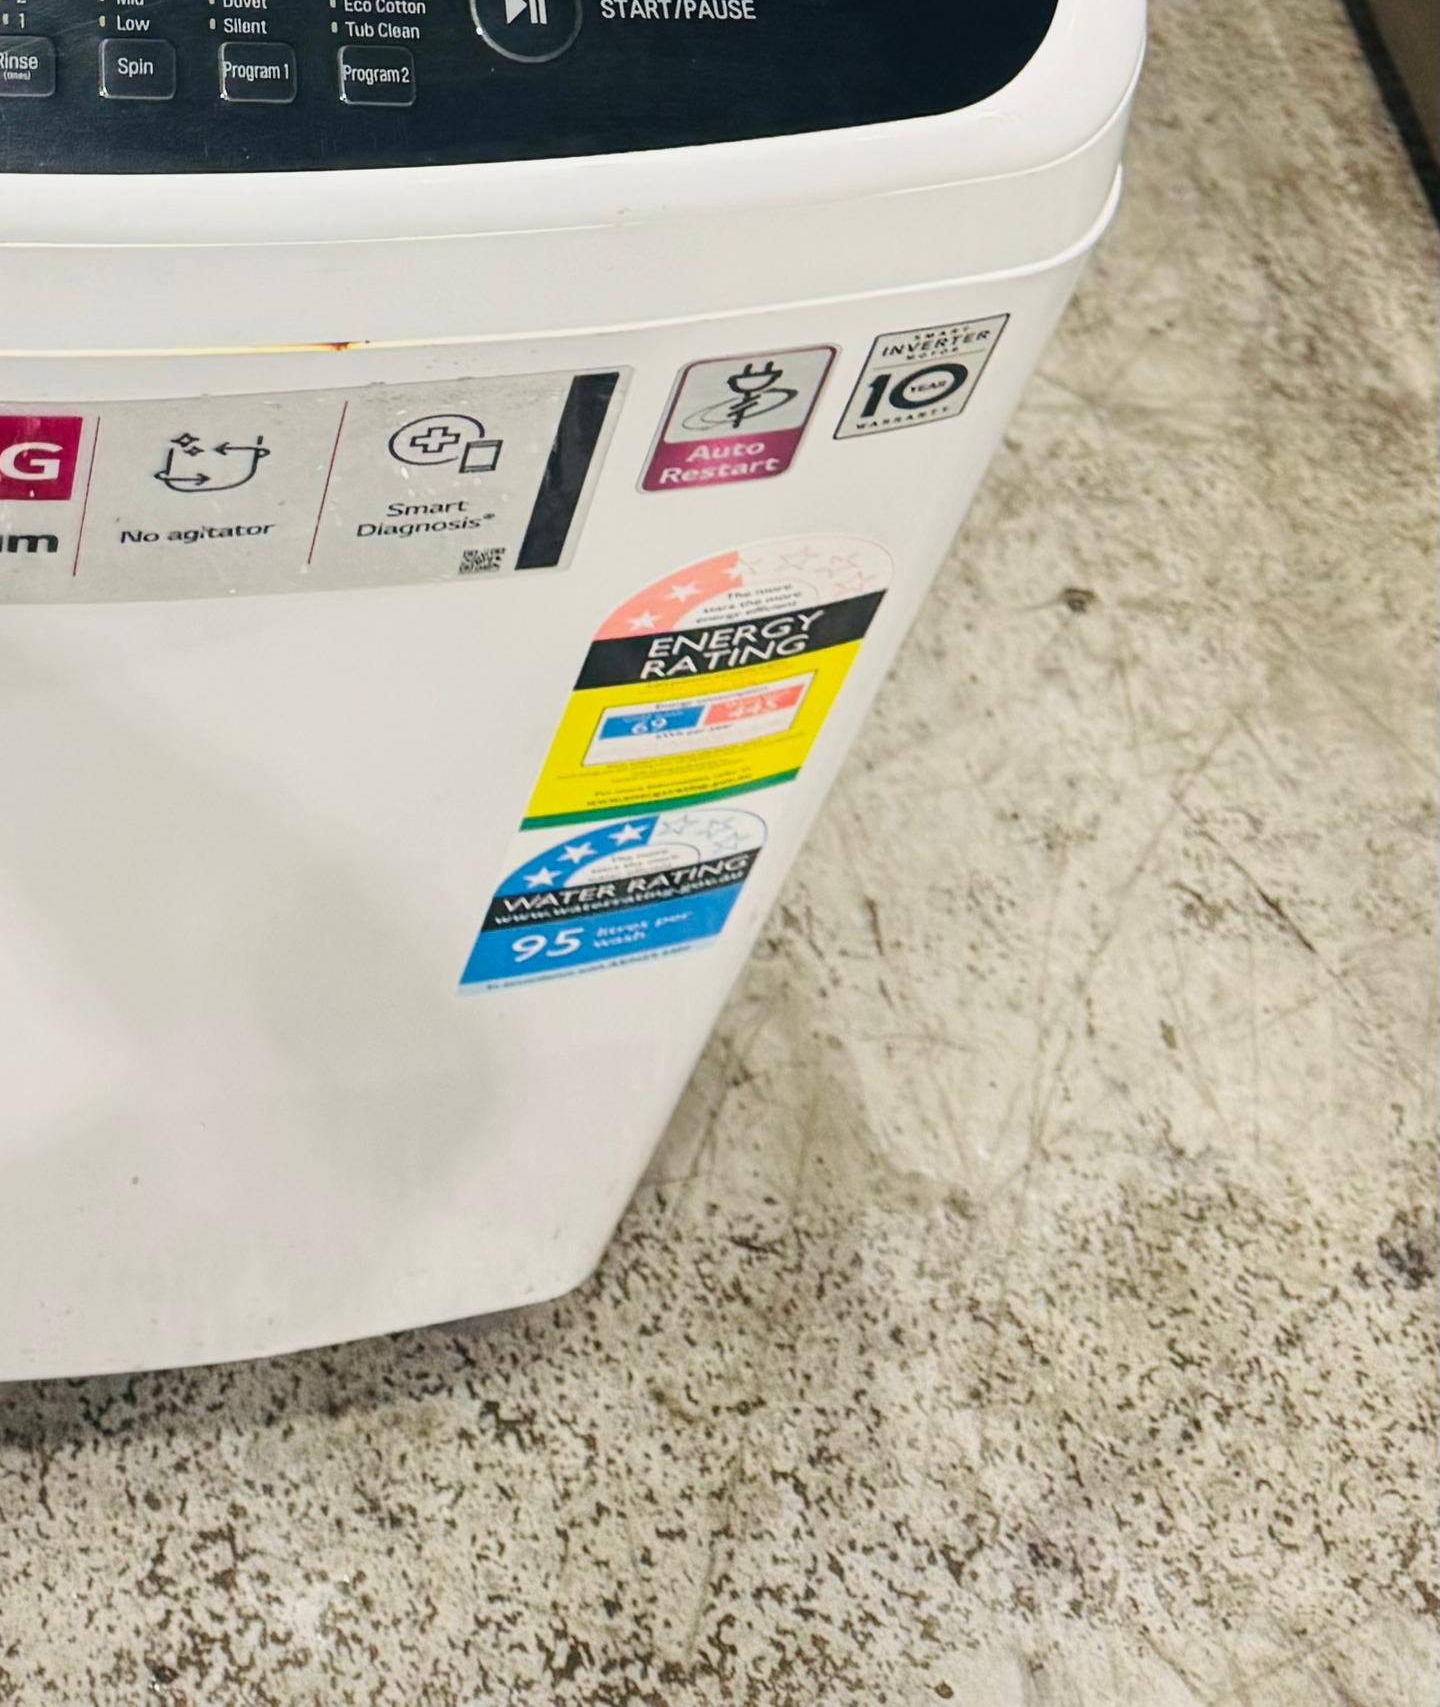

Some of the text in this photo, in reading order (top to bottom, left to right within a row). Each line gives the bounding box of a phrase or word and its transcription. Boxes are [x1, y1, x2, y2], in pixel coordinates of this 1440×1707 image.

[18, 13, 25, 29] 1
[116, 15, 150, 31] Low
[223, 18, 267, 34] Silent
[345, 21, 420, 39] Tub Clean
[117, 58, 154, 77] Spin
[224, 61, 281, 82] Program
[882, 330, 991, 357] INVERTER
[906, 347, 958, 360] MOTOR
[861, 363, 968, 417] 10
[910, 380, 947, 392] YEAR
[856, 406, 949, 429] WARRANTY
[686, 441, 766, 462] Auto
[660, 457, 781, 484] Restart
[387, 499, 470, 518] Smart
[120, 523, 275, 545] No agitator
[648, 610, 825, 658] ENERGY
[640, 634, 809, 679] RATING
[503, 884, 616, 912] WATER
[627, 854, 750, 894] RATING
[512, 927, 585, 963] 95
